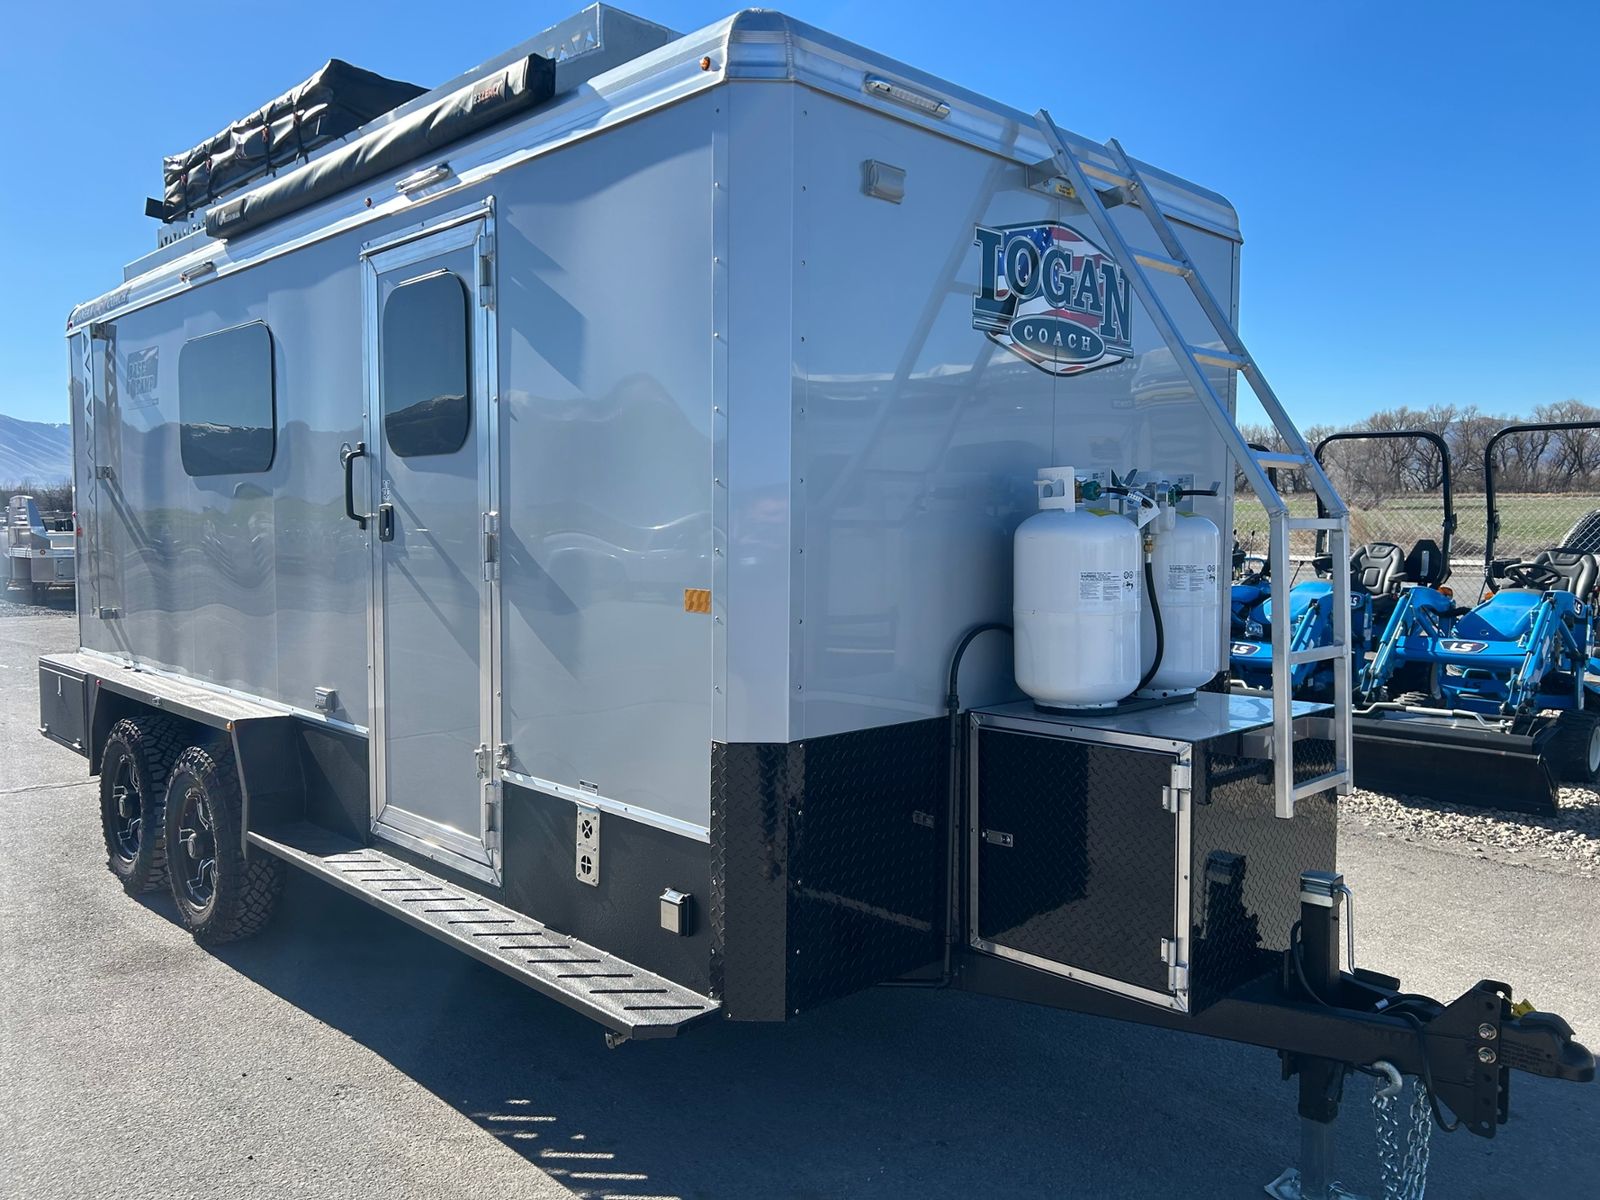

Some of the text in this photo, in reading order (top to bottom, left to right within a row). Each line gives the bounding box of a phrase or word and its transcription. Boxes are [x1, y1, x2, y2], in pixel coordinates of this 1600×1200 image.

[973, 225, 1132, 345] LOGAN
[1023, 324, 1092, 352] COACH
[1231, 645, 1250, 655] LS
[1449, 642, 1474, 652] LS
